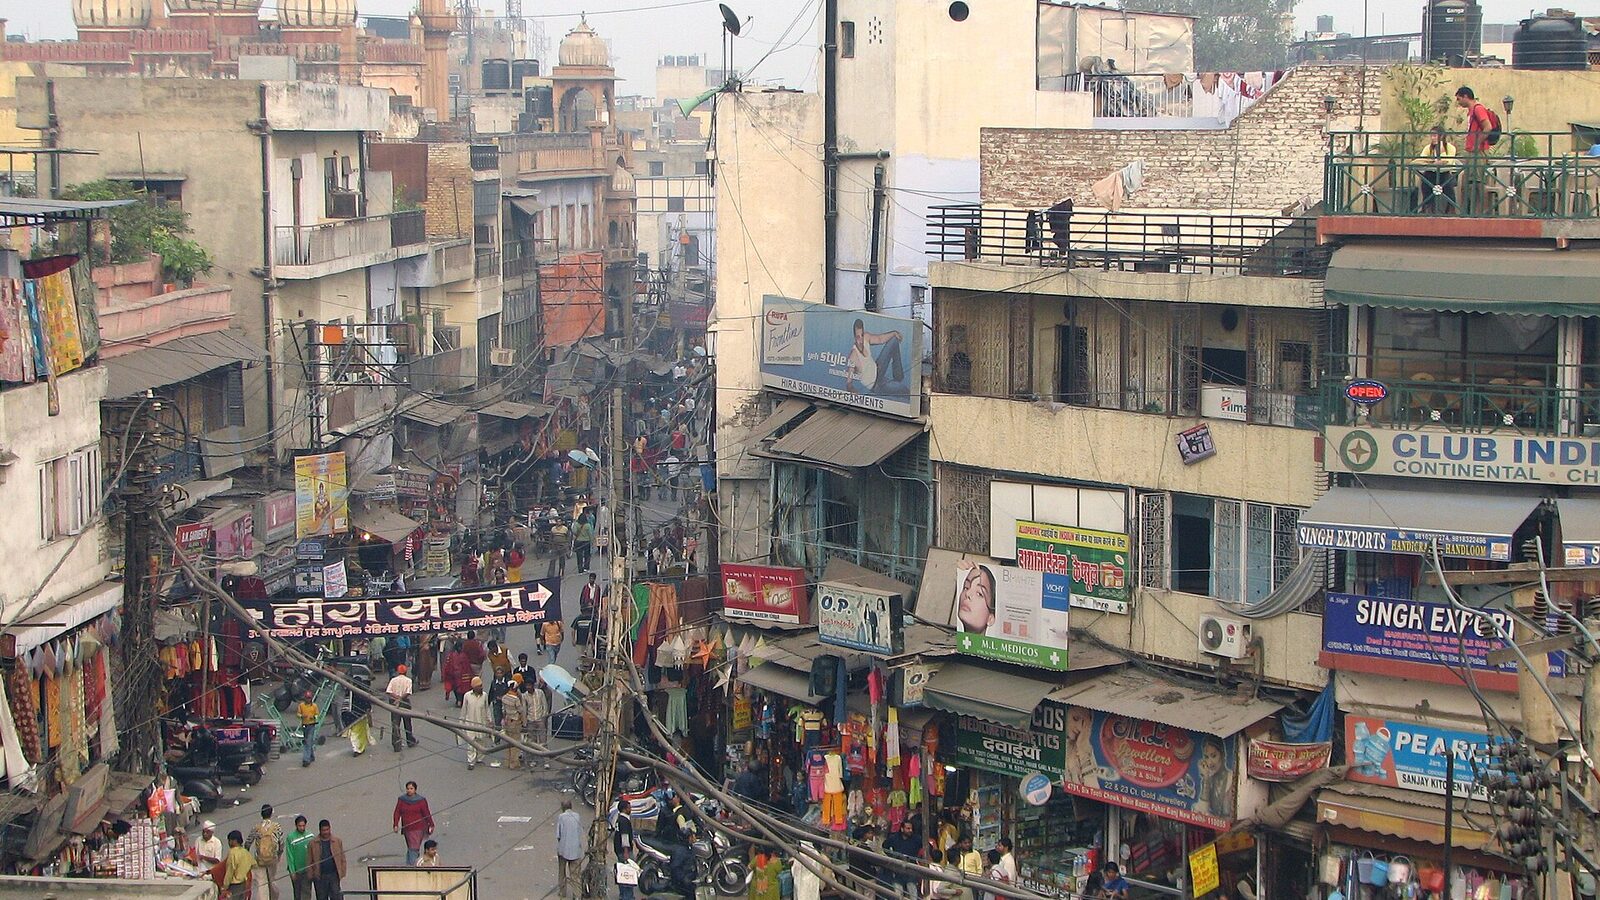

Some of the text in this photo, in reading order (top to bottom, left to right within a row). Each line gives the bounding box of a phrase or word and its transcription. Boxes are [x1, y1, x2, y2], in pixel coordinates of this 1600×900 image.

[820, 352, 847, 367] style
[781, 379, 884, 409] HIRA SONS READY GARMENTS
[1349, 387, 1383, 398] OPEN
[1392, 433, 1498, 462] CLUB
[1393, 460, 1541, 481] CONTINENTAL
[1299, 526, 1335, 547] SINGH
[1336, 530, 1388, 551] EXPORTS
[1391, 538, 1432, 553] HANDICRA
[1445, 544, 1487, 557] HANDLOOM
[1046, 584, 1065, 593] VICHY
[387, 587, 526, 620] सन्स
[821, 595, 851, 615] O.P.
[506, 613, 516, 623] के
[1356, 599, 1515, 639] SINGH EXPORT
[981, 640, 998, 651] M.L.
[1000, 644, 1039, 658] MEDICOS
[1394, 731, 1490, 764] PEARL
[1146, 773, 1163, 783] Silver
[1402, 774, 1486, 797] SANJAY KITCEN WRE
[1104, 781, 1113, 790] 22
[1141, 790, 1156, 800] Gold
[1157, 794, 1188, 809] Jewellery
[1151, 803, 1166, 813] Pahar
